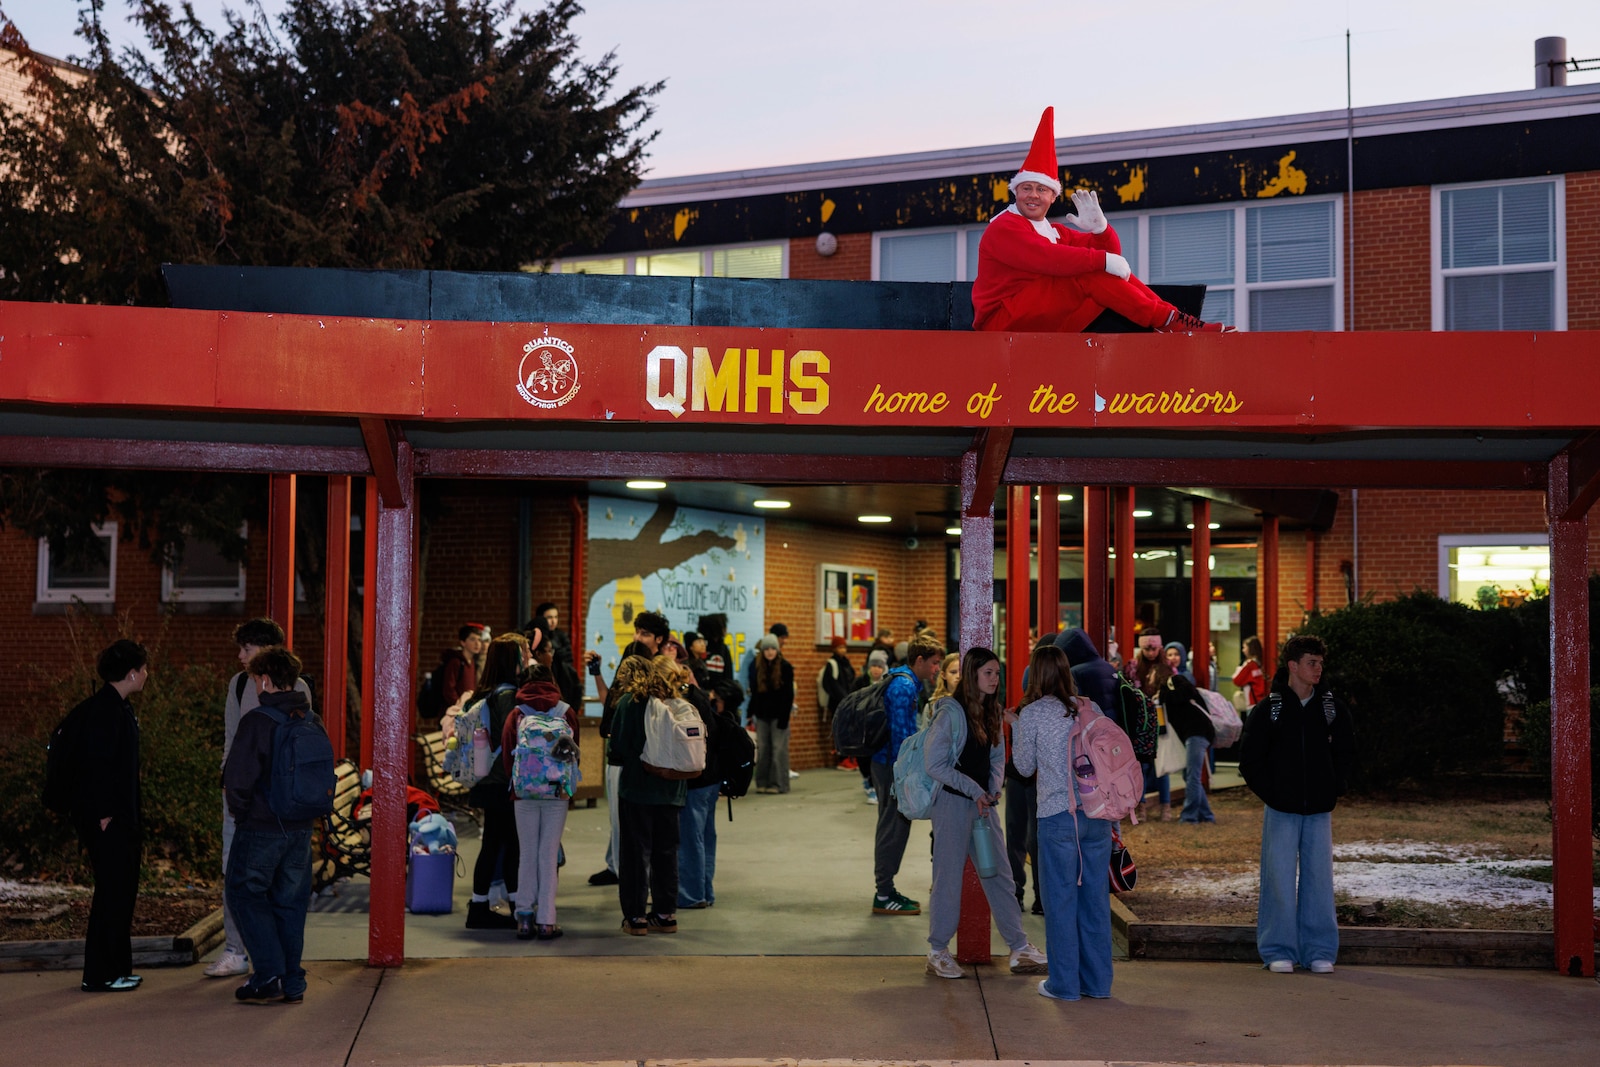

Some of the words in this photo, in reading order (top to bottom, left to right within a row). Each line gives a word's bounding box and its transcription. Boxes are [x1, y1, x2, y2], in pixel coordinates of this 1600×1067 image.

[523, 336, 575, 353] QUANTICO
[557, 383, 582, 407] SCHOOL
[645, 345, 831, 419] QMHS
[863, 383, 950, 413] home
[966, 382, 1002, 419] of
[1028, 384, 1079, 413] the
[1108, 388, 1244, 414] warriors
[661, 581, 709, 611] WELCOME
[718, 584, 748, 612] QMHS
